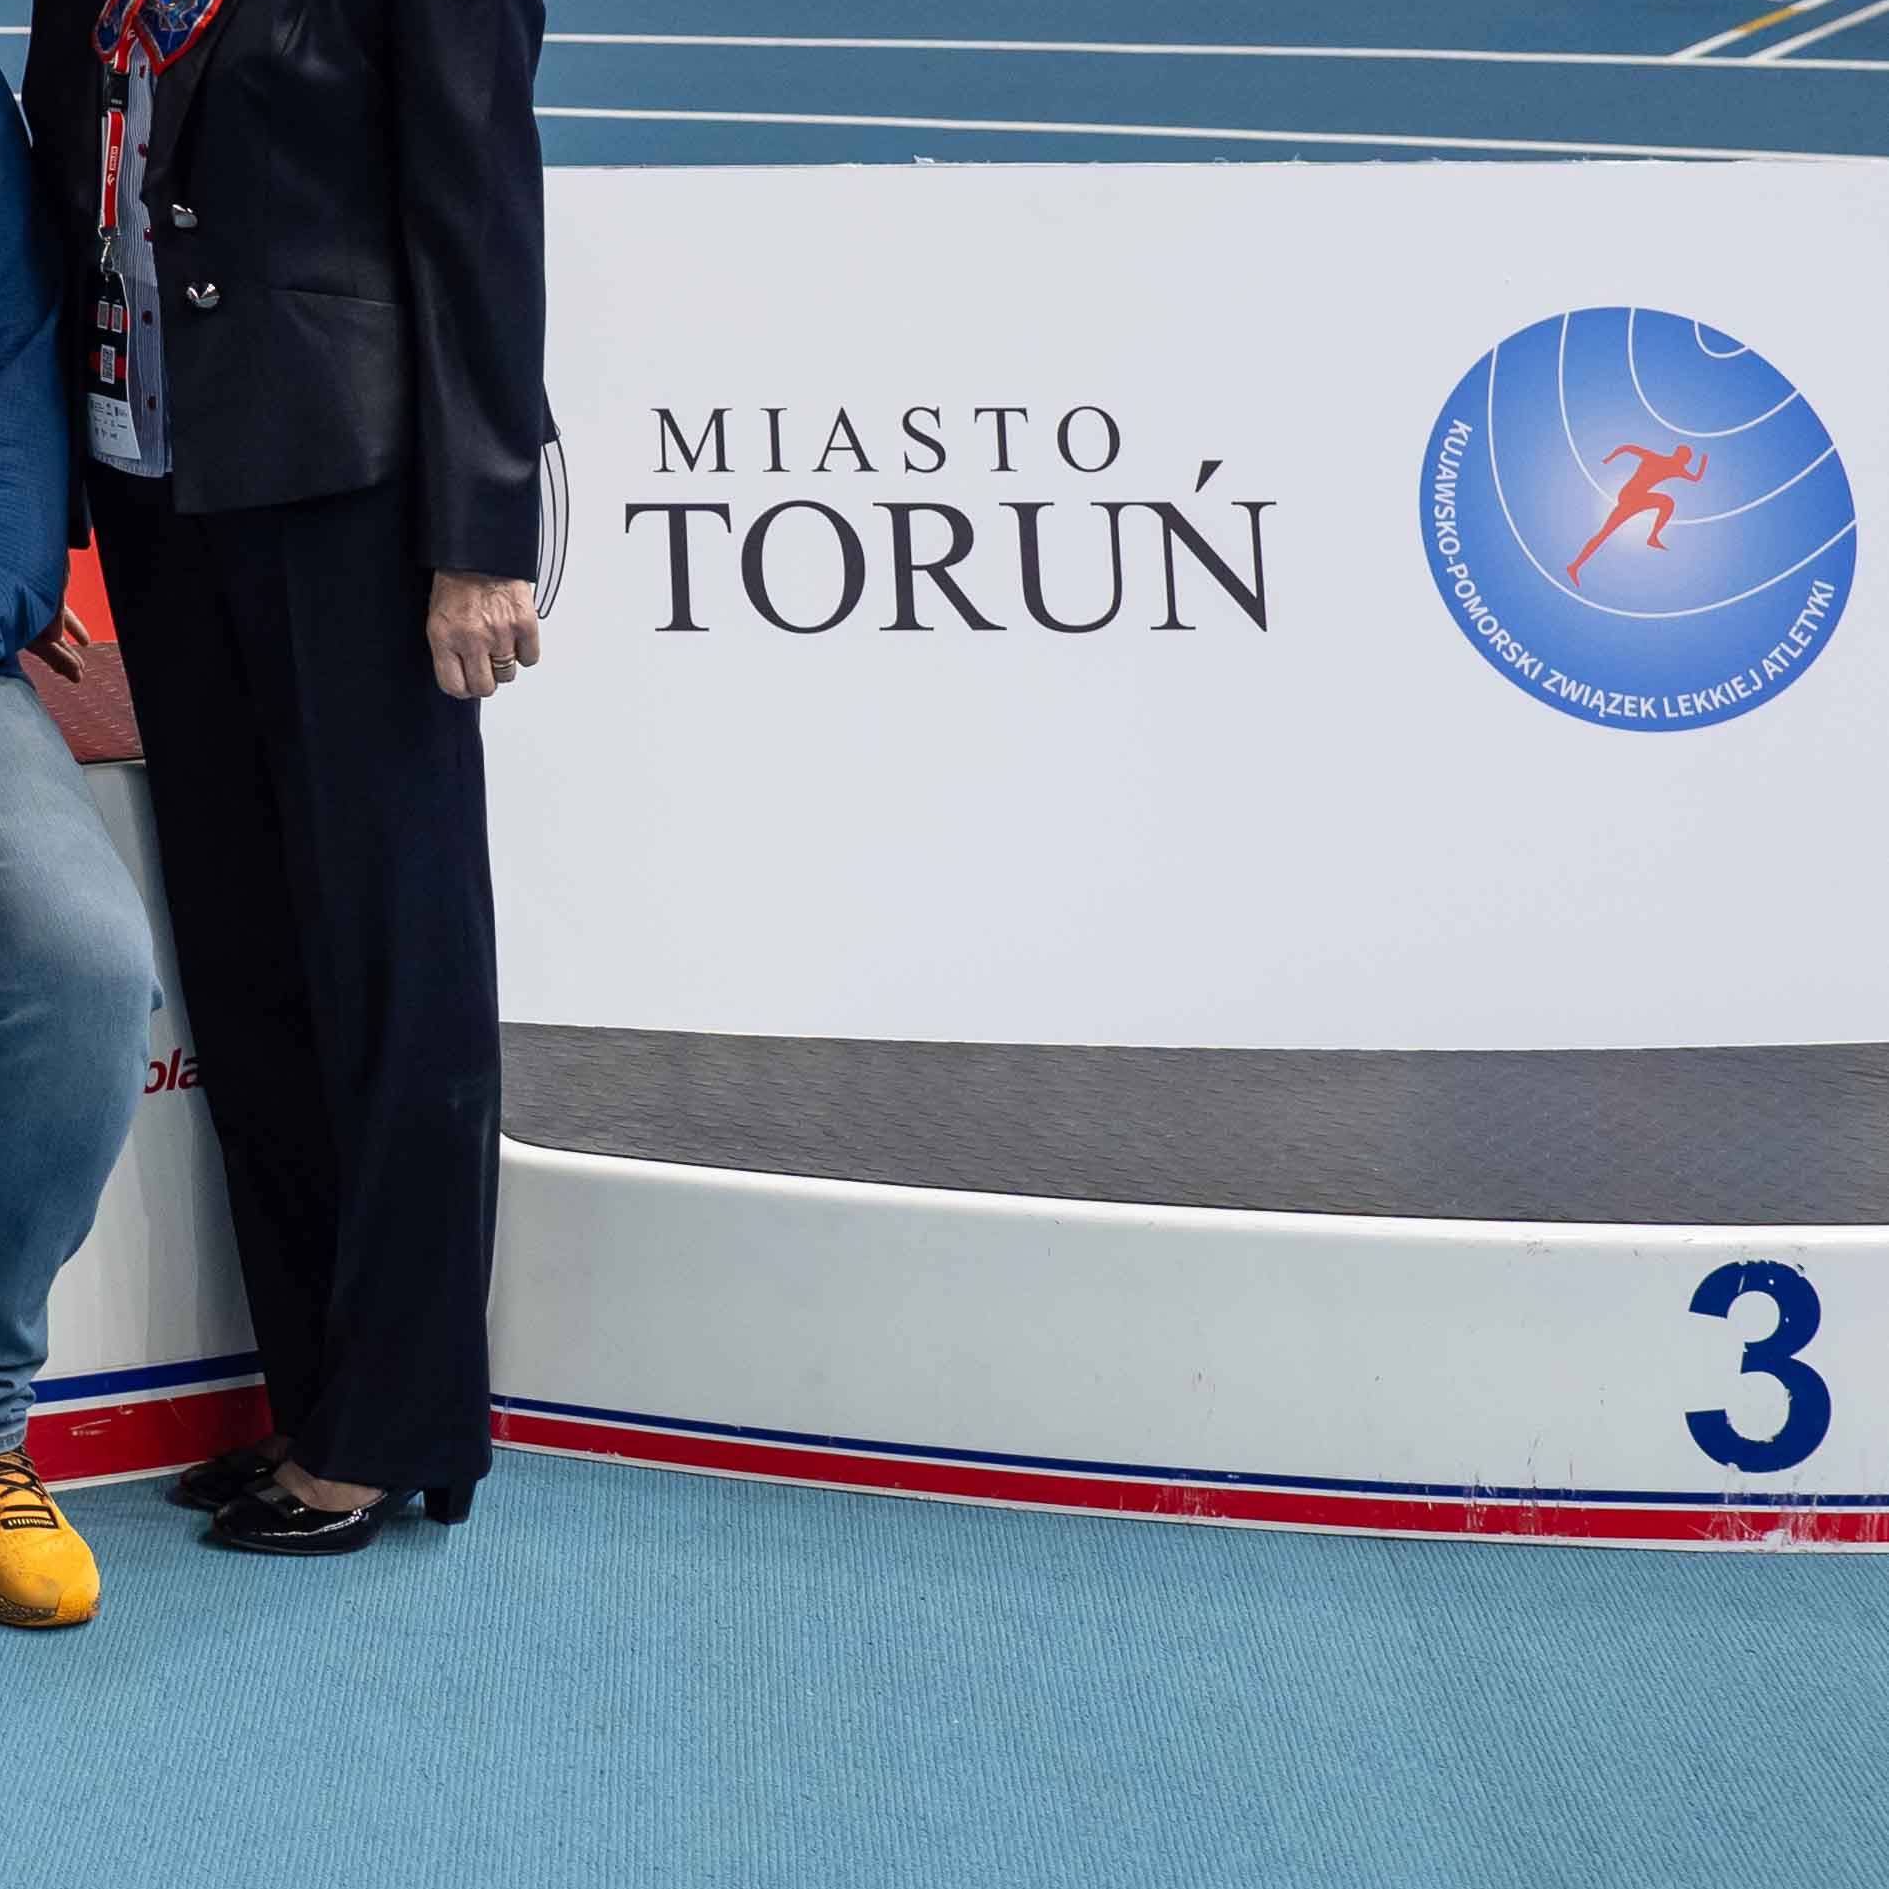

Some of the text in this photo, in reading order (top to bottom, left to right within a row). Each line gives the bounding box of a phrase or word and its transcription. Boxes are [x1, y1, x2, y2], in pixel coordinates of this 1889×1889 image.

[651, 407, 1121, 473] MIASTO
[625, 460, 1277, 634] TORUŃ
[1434, 419, 1836, 718] KUJAWSKO-POMORSKI ZWIĄZEK LEKKIEJ ATLETYKI
[1684, 1259, 1831, 1474] 3
